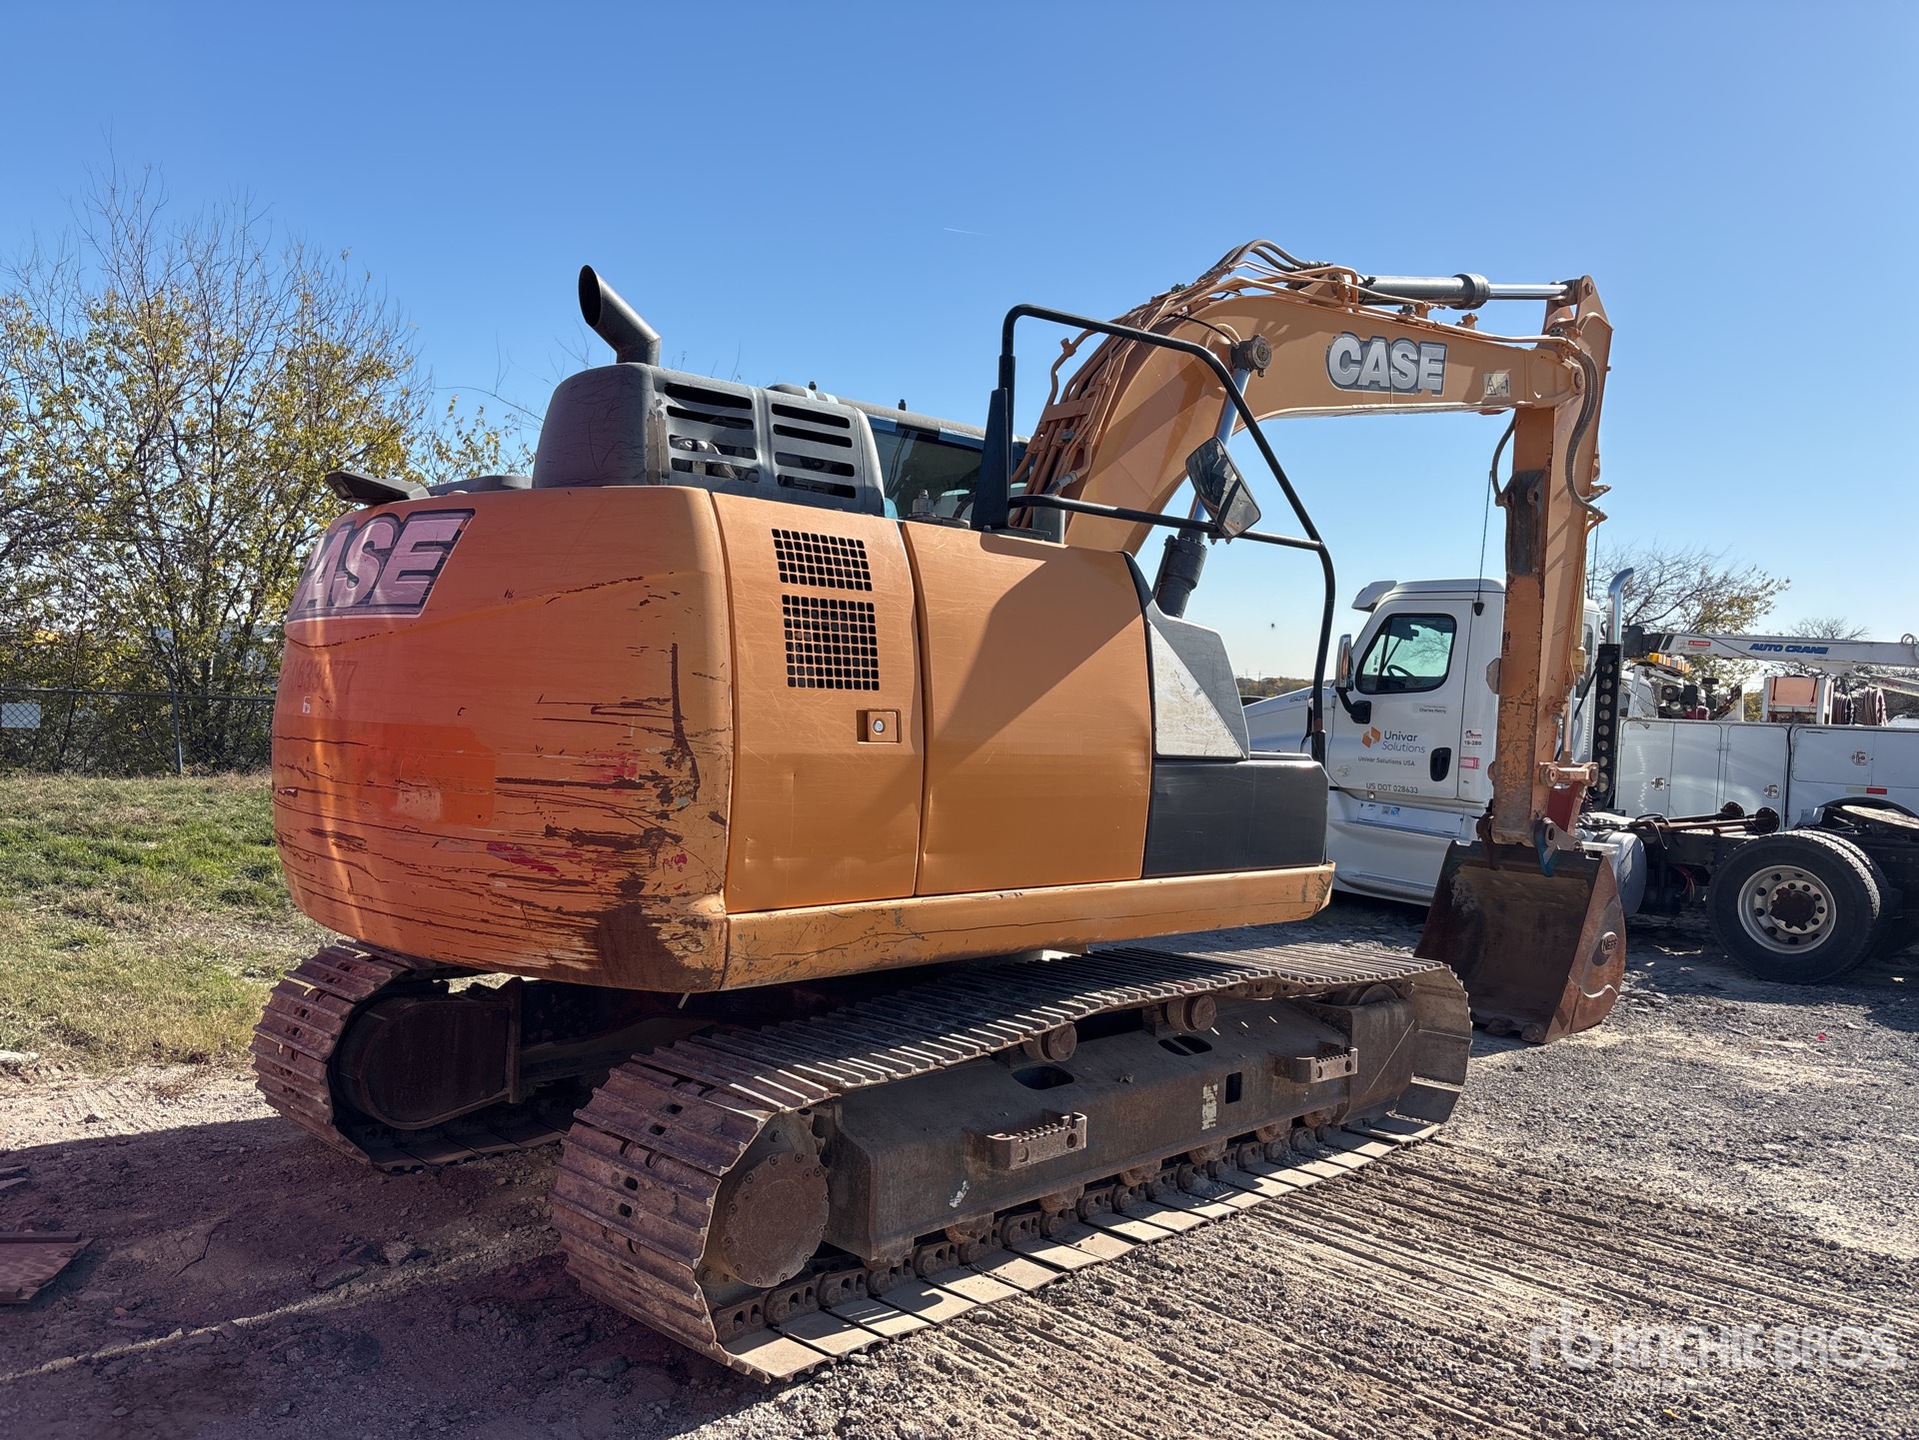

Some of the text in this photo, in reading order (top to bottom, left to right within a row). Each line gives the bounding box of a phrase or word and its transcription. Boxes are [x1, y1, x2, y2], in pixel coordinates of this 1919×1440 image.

[1327, 333, 1447, 394] CASE
[1749, 643, 1829, 655] AUTO CRANE
[1384, 730, 1418, 742] Univar
[1382, 741, 1426, 753] Solutions
[1376, 757, 1402, 765] Solutions
[1366, 782, 1418, 794] US DOT 028633
